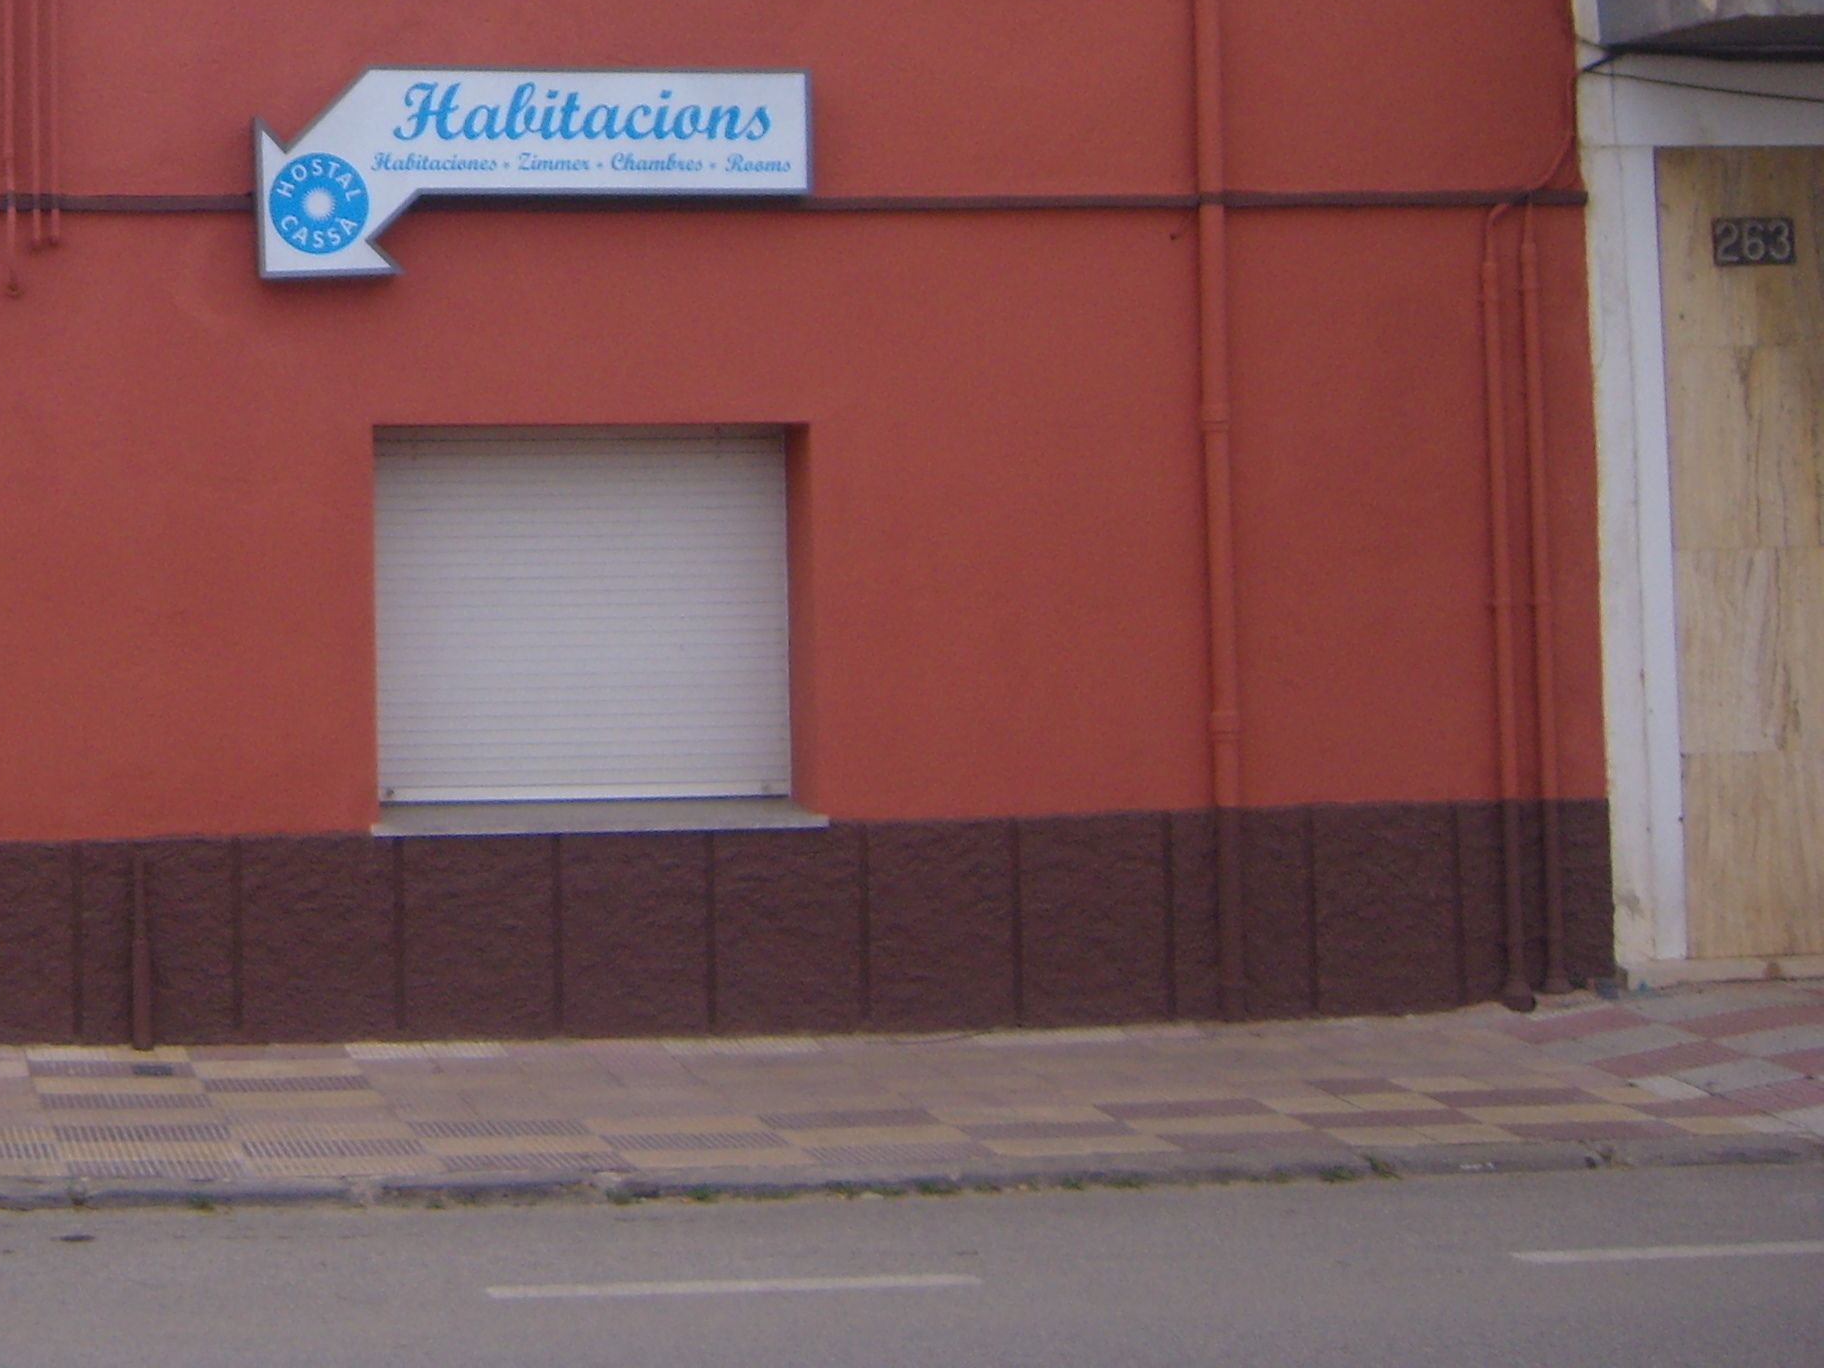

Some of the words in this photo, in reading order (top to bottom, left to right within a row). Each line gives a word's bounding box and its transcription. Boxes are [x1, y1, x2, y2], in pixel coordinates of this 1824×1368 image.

[391, 81, 772, 142] Habitacions
[276, 158, 362, 202] HOSTAL
[371, 151, 498, 172] Habitaciones
[517, 151, 590, 172] Zimmer
[610, 151, 704, 172] Chambres
[725, 152, 792, 173] Rooms
[1716, 220, 1791, 261] 263
